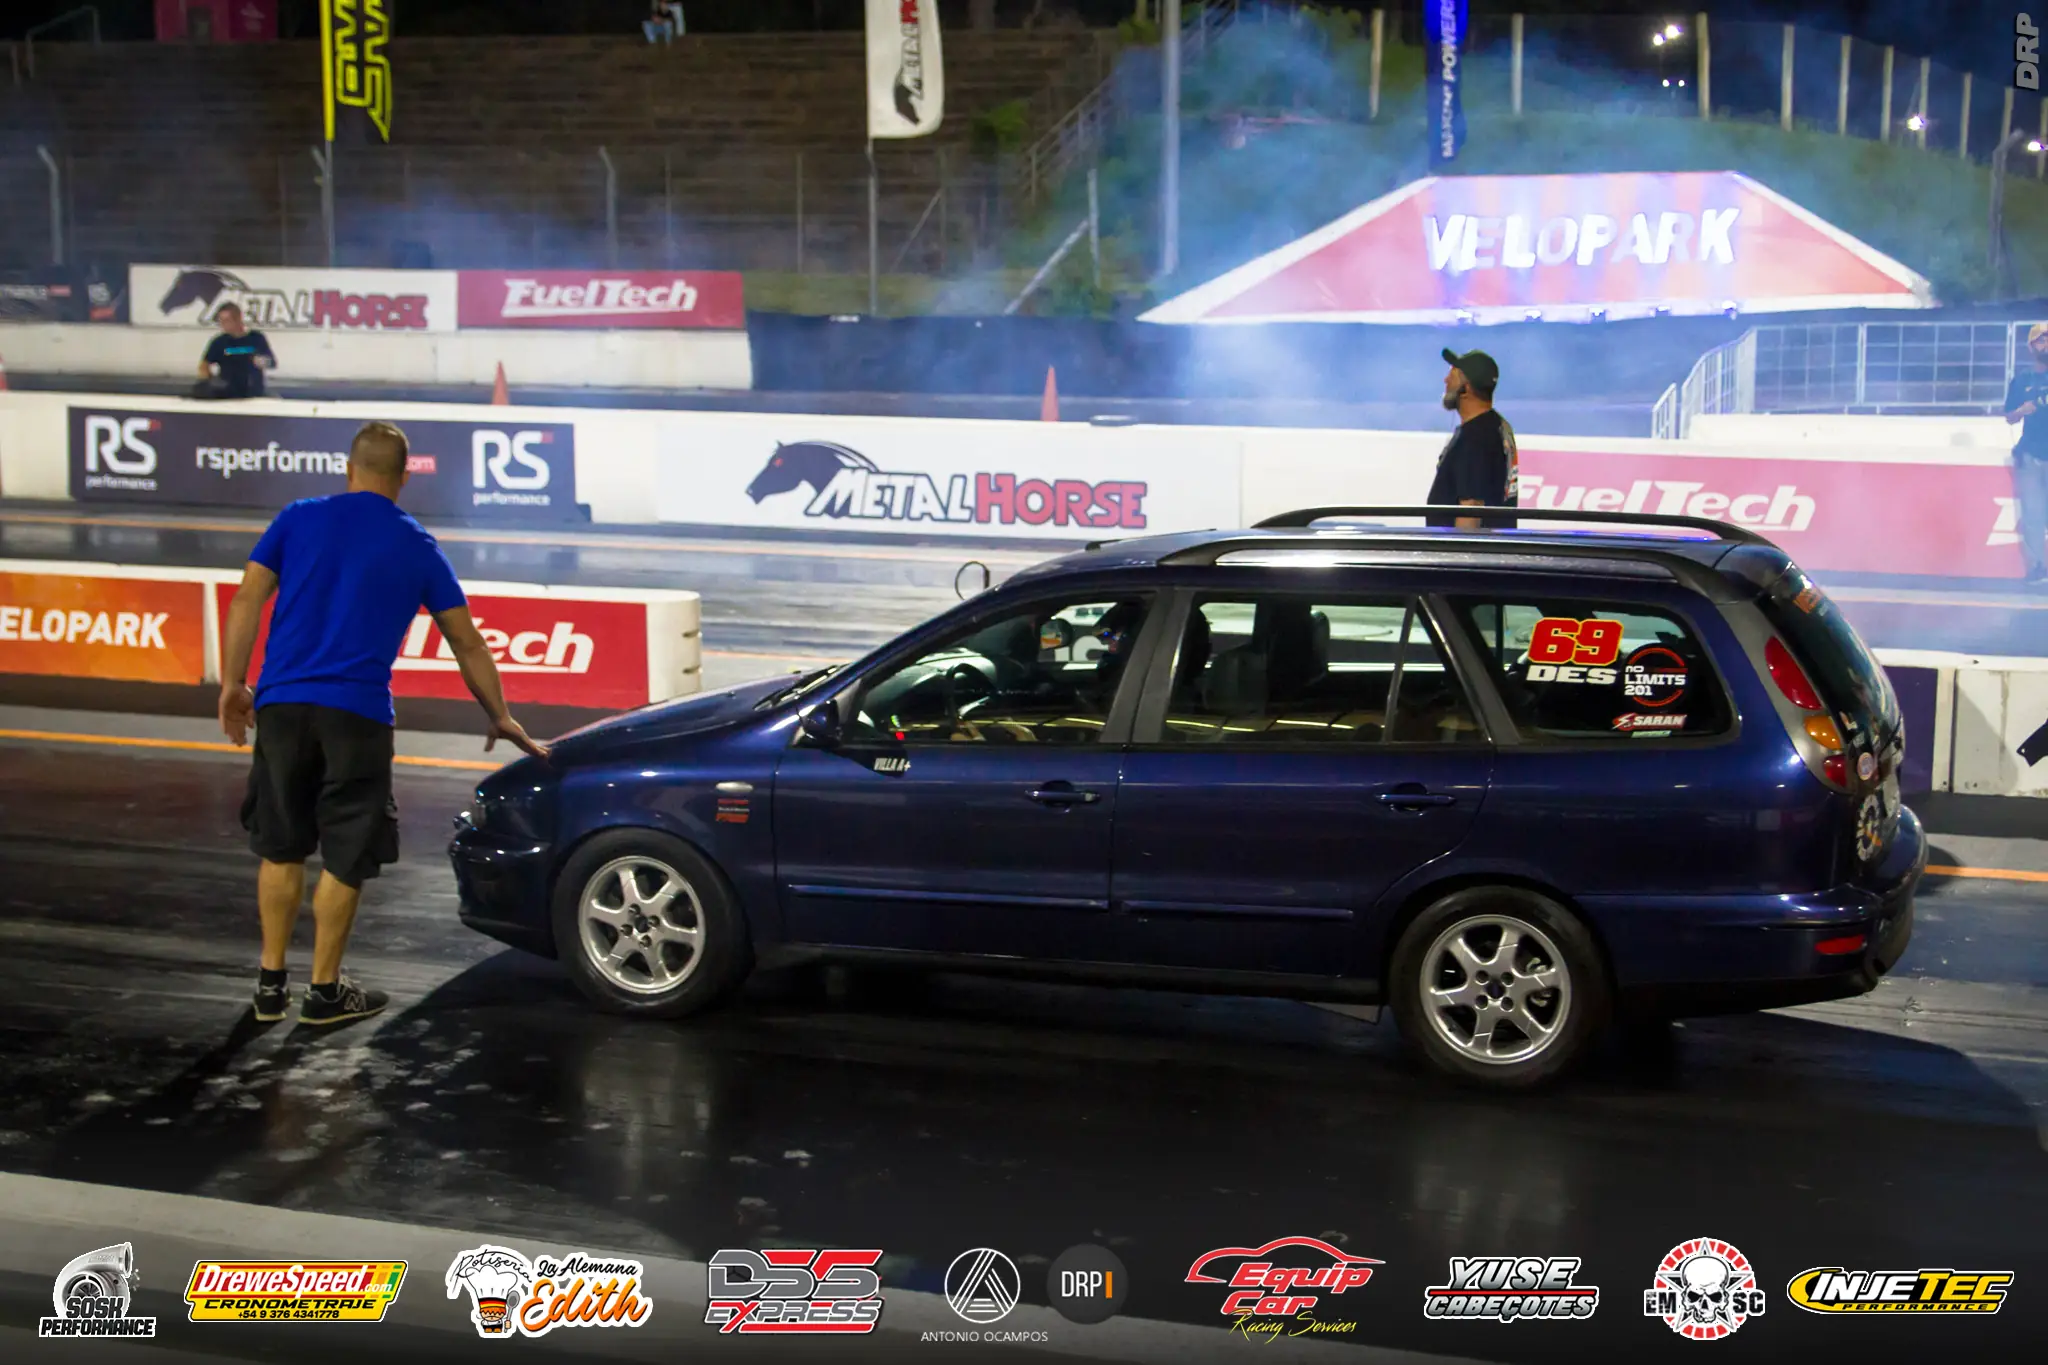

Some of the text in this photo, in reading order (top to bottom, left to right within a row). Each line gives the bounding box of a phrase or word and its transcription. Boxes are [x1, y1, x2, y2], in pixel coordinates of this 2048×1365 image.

[899, 0, 923, 100] METALH
[1423, 207, 1740, 271] VELOPARK
[501, 278, 698, 318] FuelTech
[86, 415, 157, 475] RS
[472, 429, 550, 490] RS
[86, 475, 157, 491] performance
[472, 493, 551, 506] performance
[804, 467, 1148, 529] METALHORSE
[0, 605, 169, 649] ELOPARK
[1528, 617, 1624, 666] 69
[1526, 665, 1620, 685] DES
[1624, 674, 1686, 686] LIMITS
[1624, 685, 1653, 696] 201
[1633, 714, 1687, 726] SARAN
[874, 758, 896, 771] VILLA
